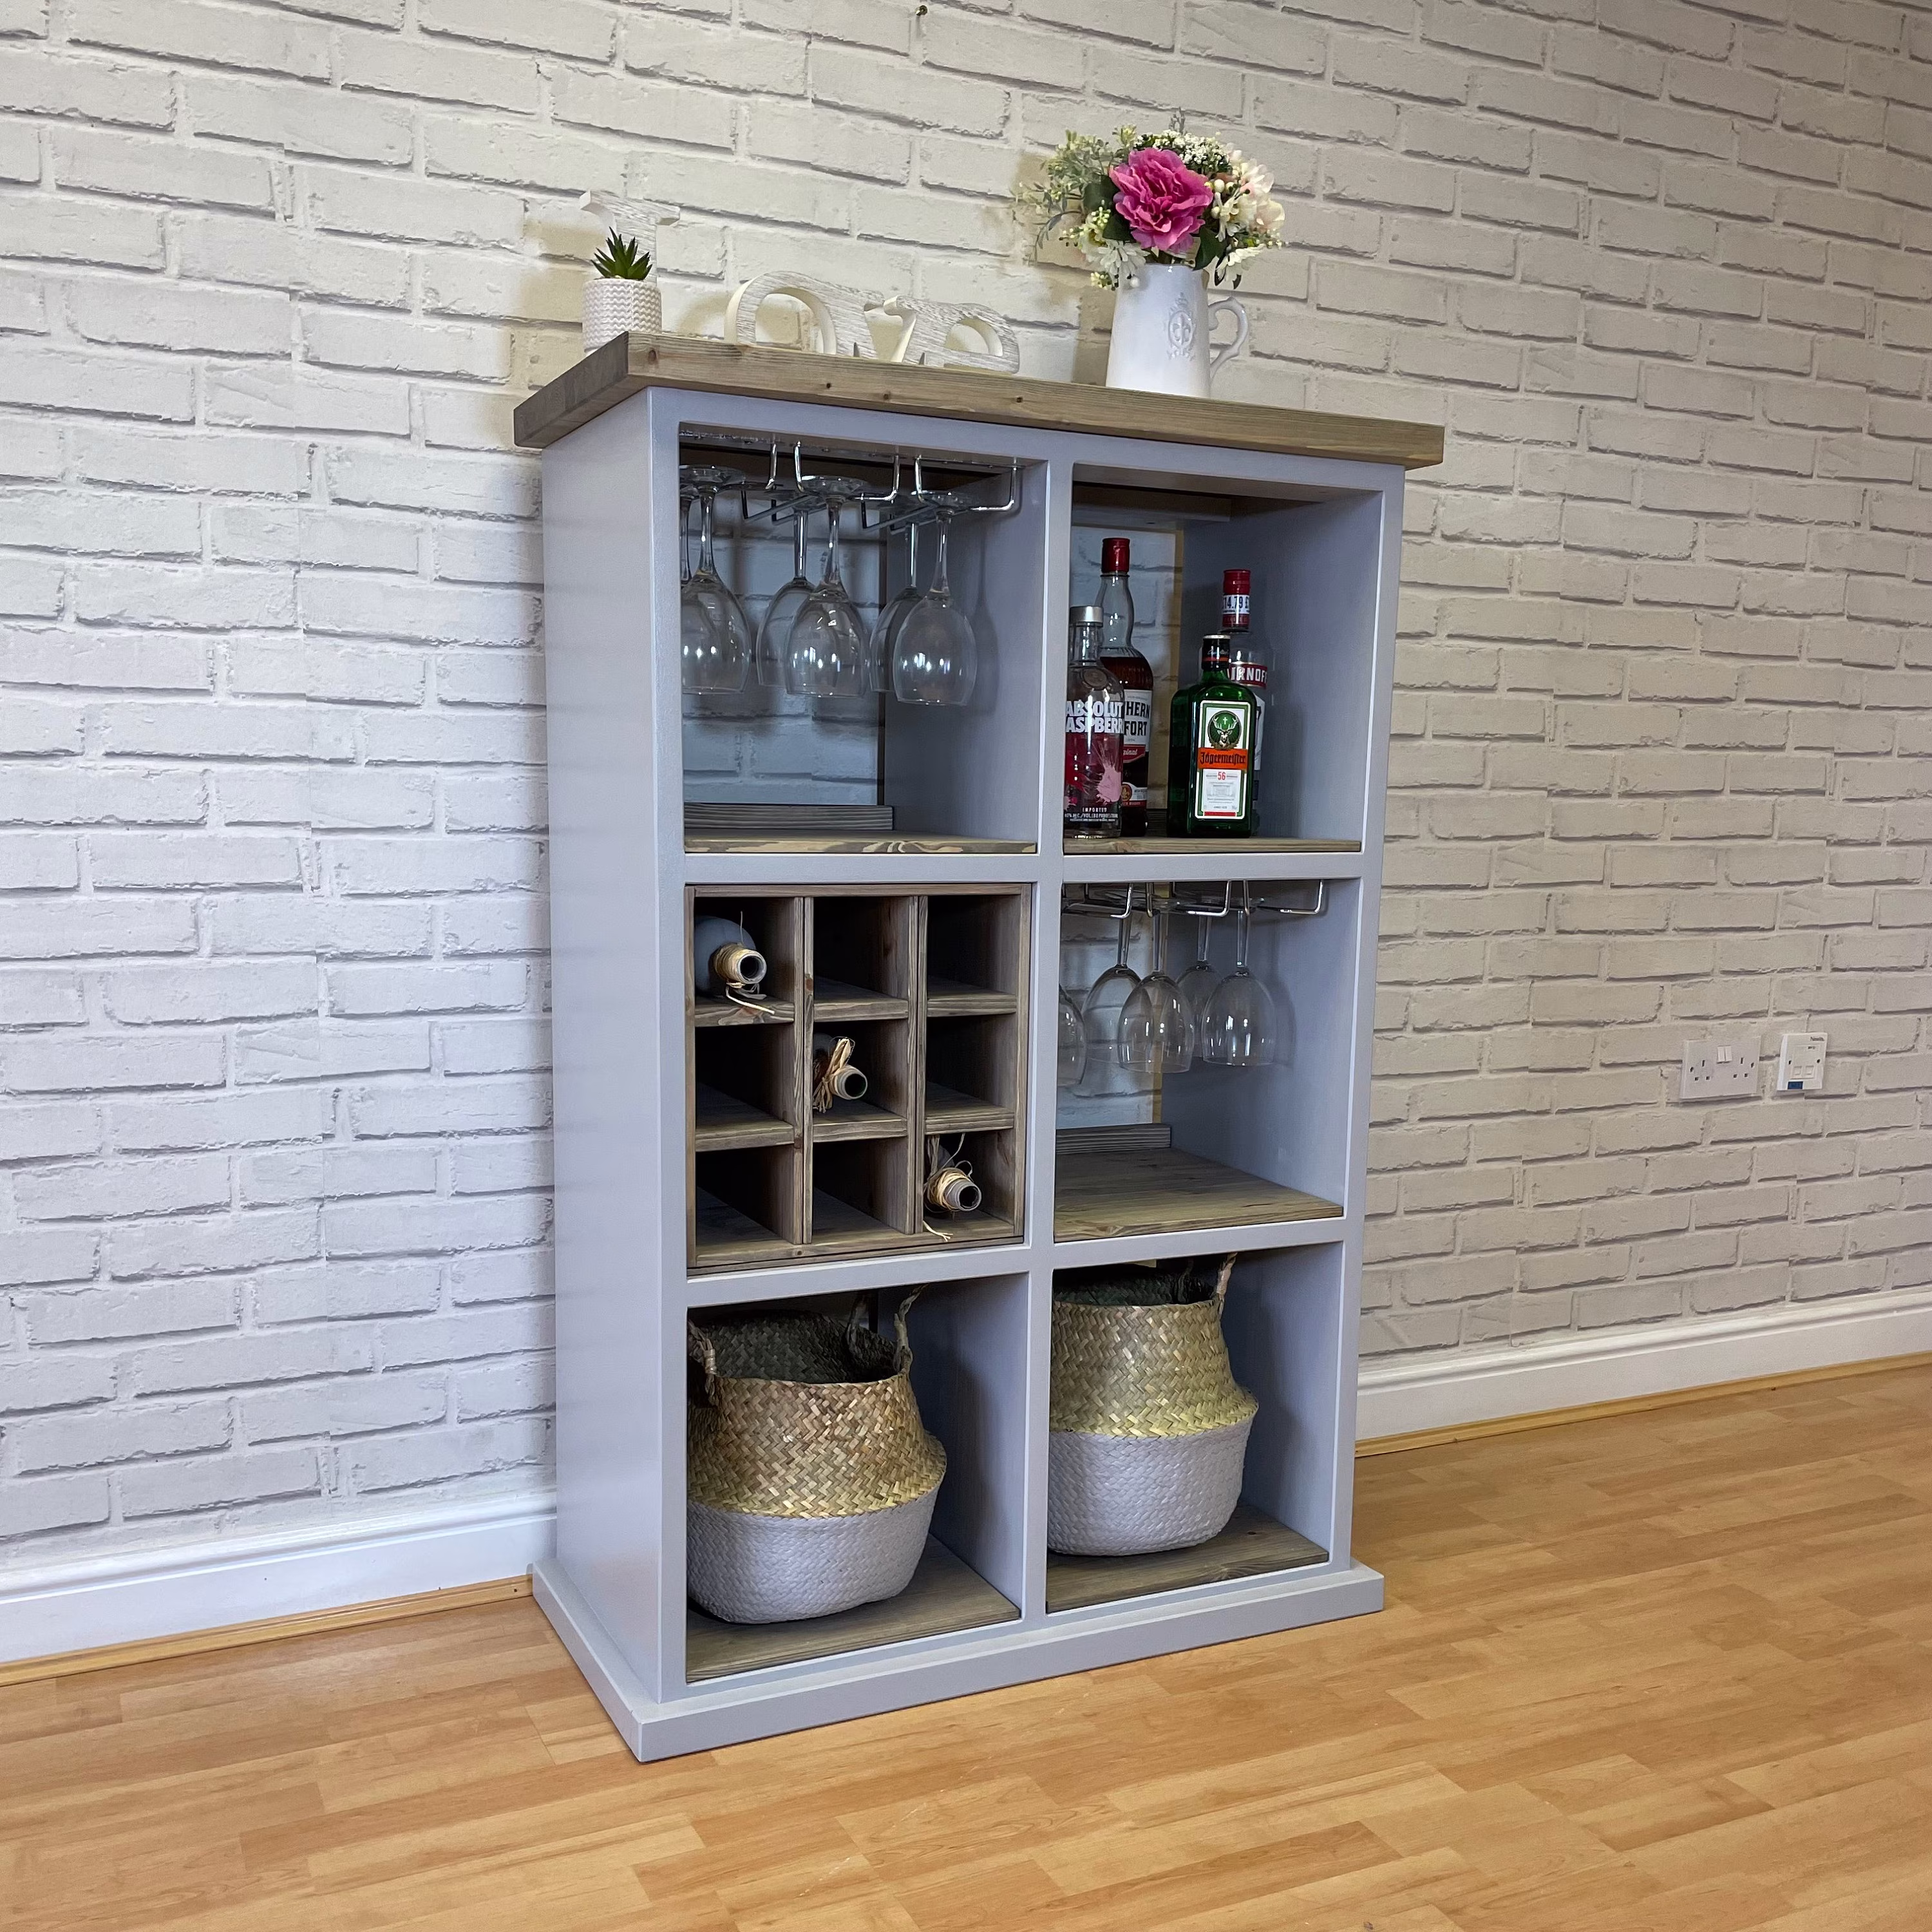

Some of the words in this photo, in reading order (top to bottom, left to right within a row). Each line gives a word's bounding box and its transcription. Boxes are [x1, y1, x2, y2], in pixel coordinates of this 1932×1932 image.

[1066, 701, 1123, 717] ABSOLUT
[1126, 701, 1150, 719] HERN
[1066, 717, 1124, 734] ASPBERR
[1124, 721, 1148, 736] FORT
[1218, 772, 1226, 781] 56
